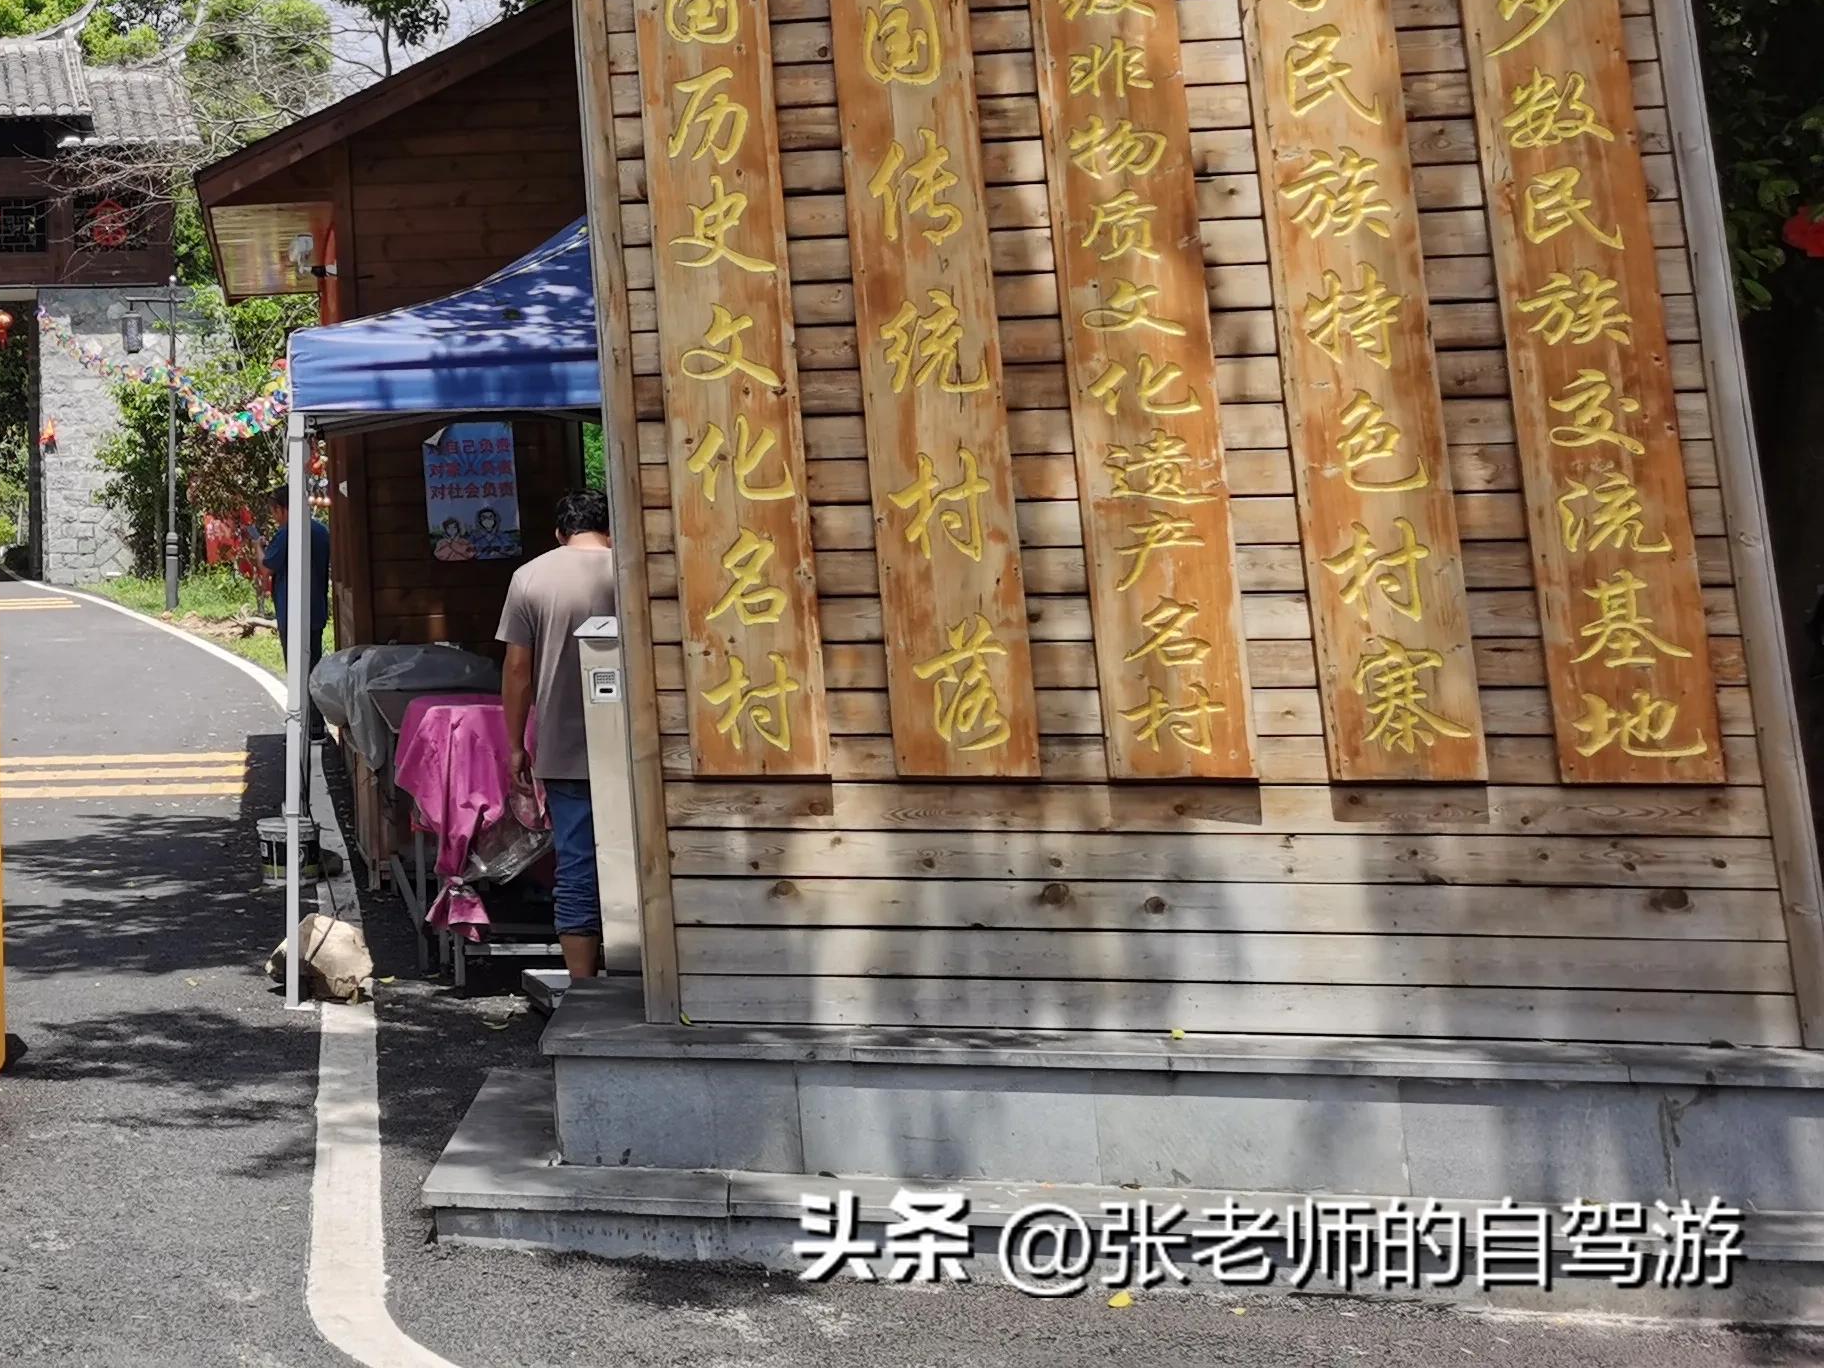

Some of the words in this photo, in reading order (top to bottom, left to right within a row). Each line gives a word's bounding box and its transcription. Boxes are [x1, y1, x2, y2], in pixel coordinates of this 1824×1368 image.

[430, 482, 515, 500] 对社会负责
